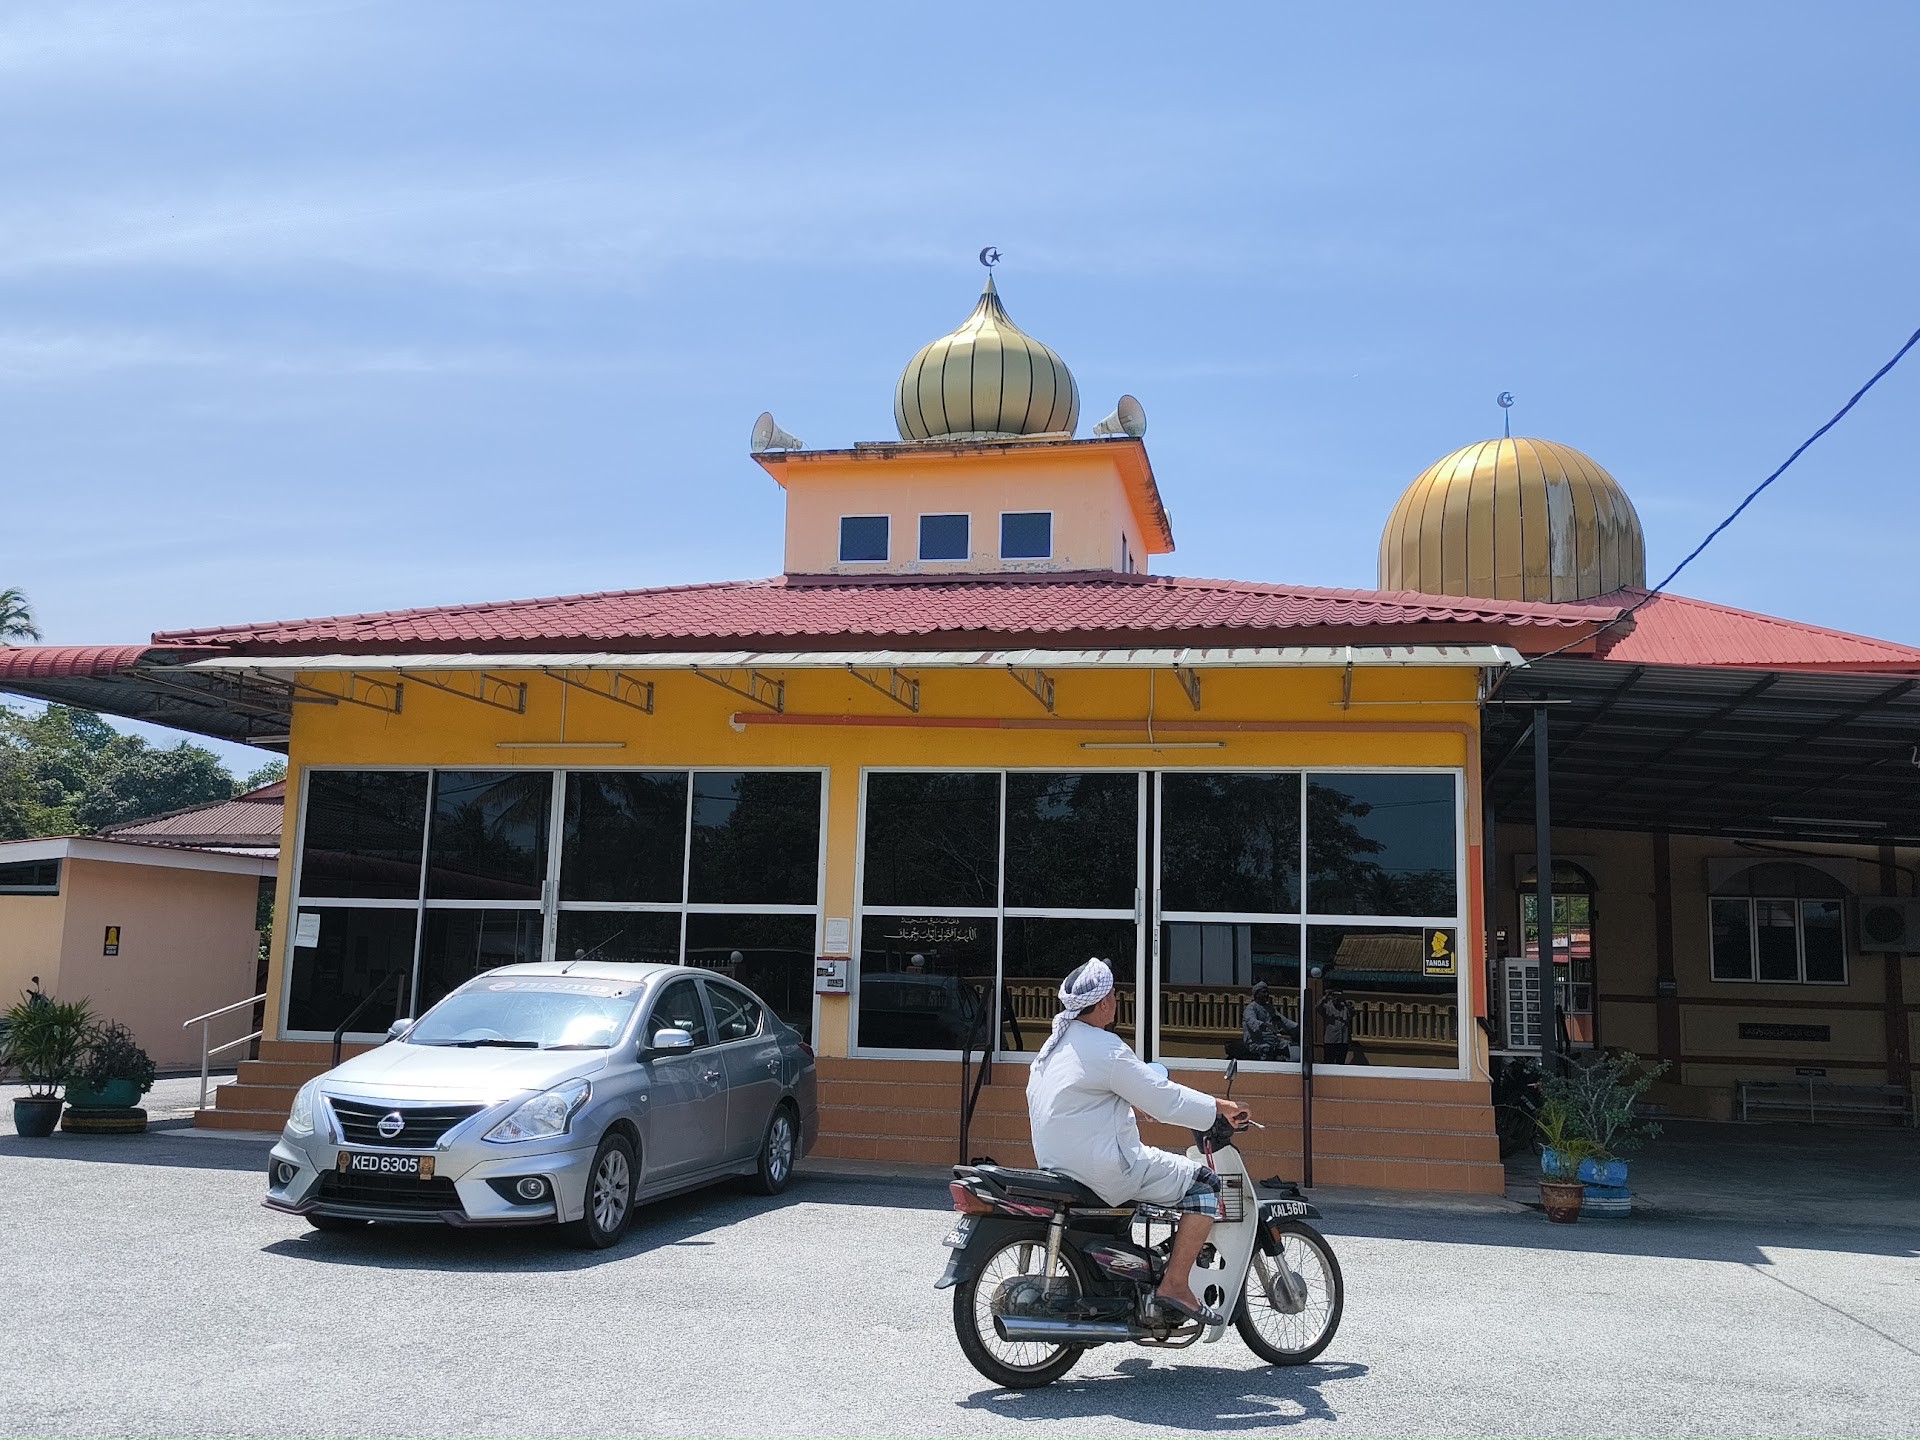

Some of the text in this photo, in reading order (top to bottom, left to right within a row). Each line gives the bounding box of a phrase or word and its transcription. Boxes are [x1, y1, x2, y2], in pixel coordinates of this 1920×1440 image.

[352, 1155, 419, 1172] KED 6305
[955, 1217, 970, 1231] KAL
[947, 1231, 968, 1245] 5601
